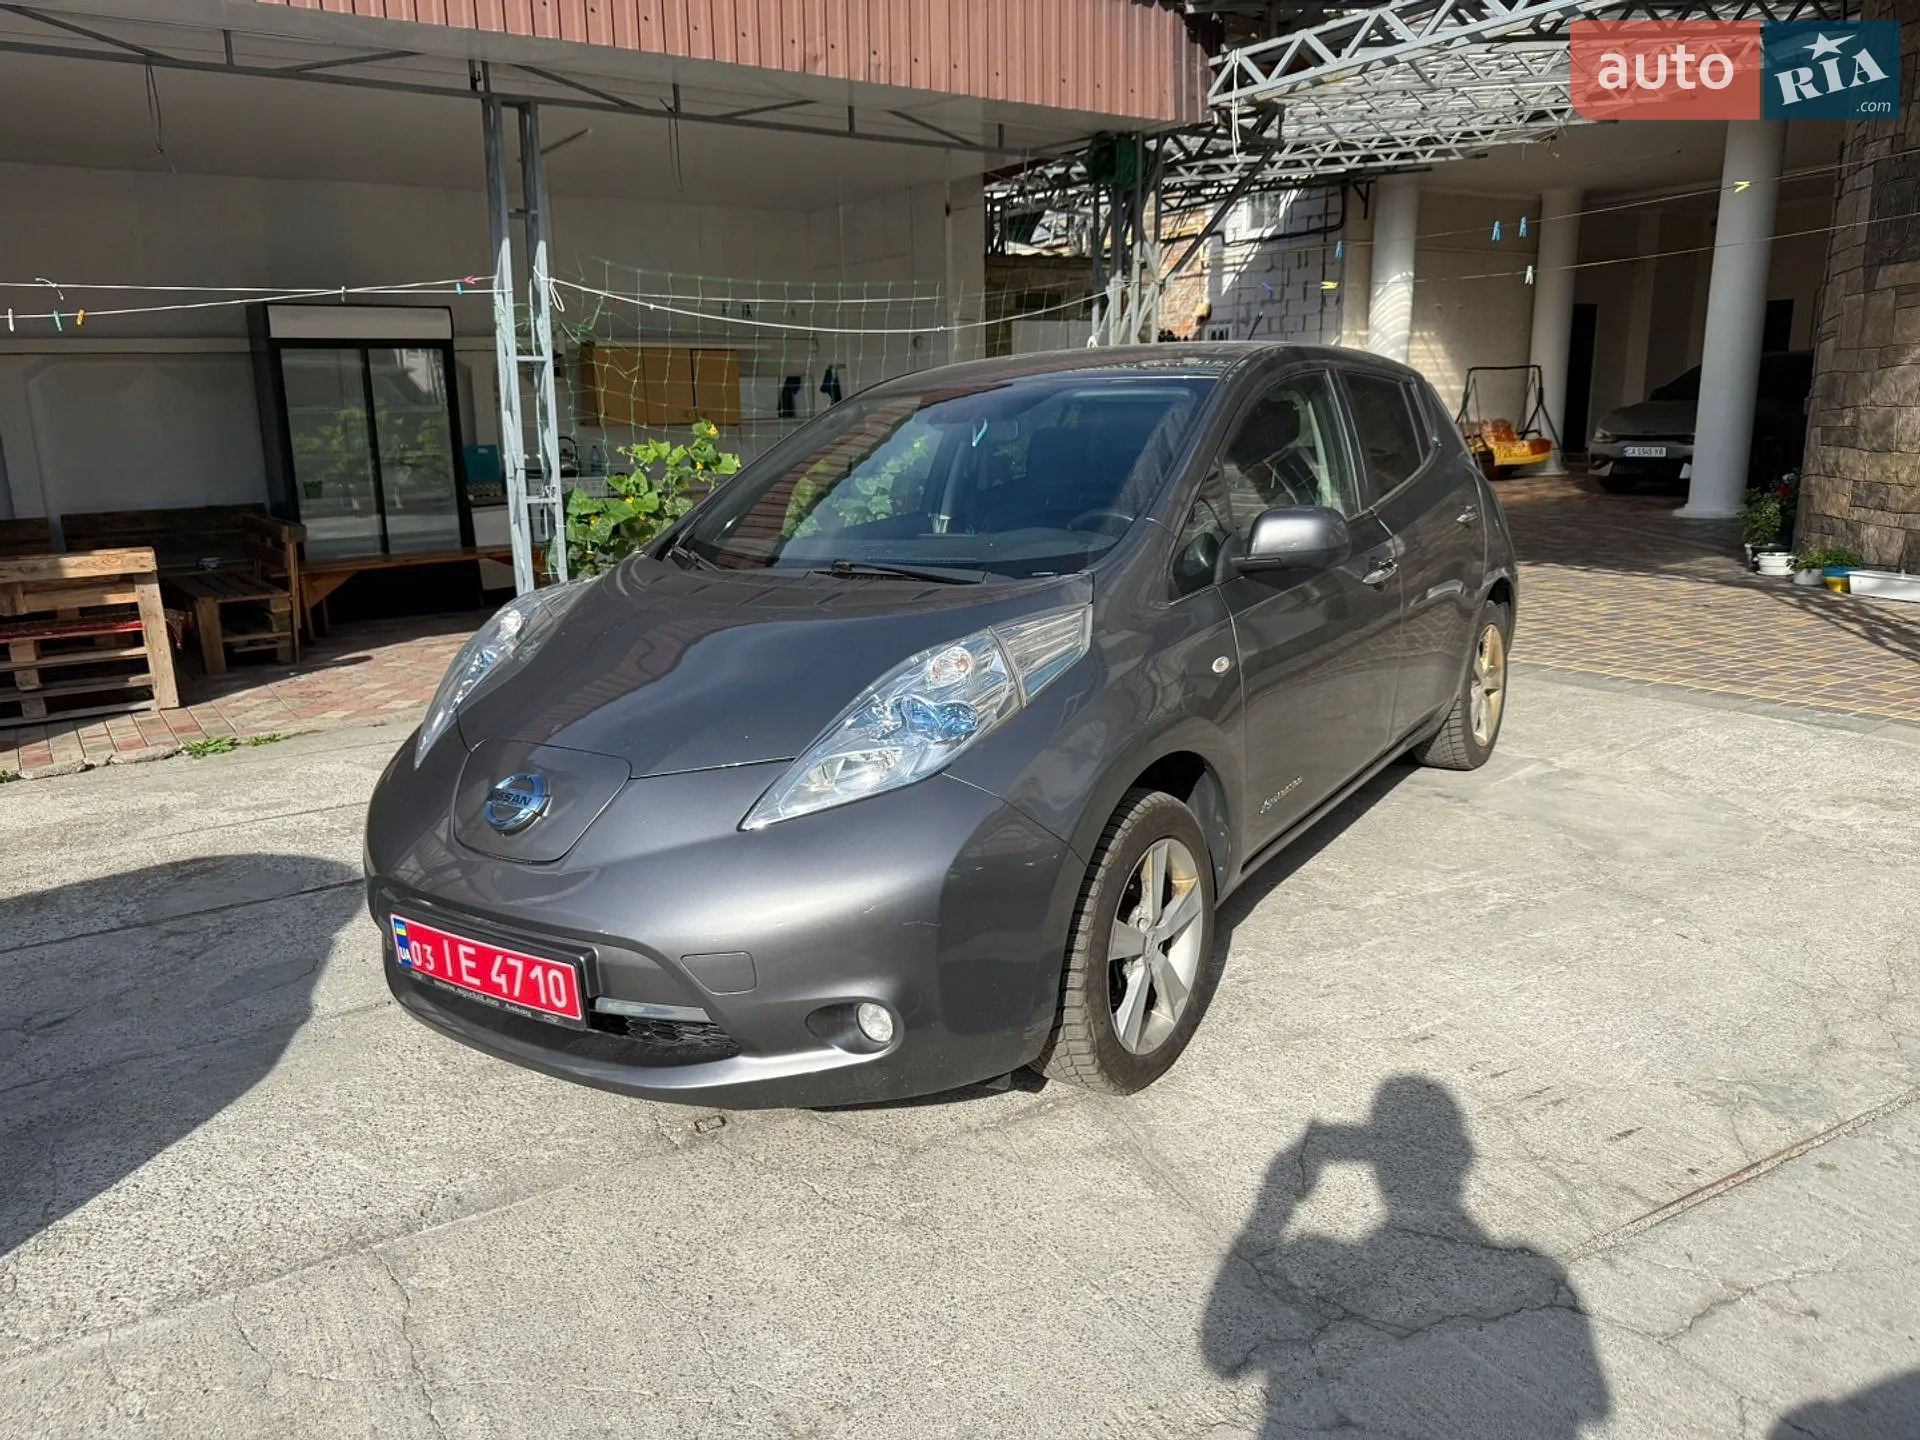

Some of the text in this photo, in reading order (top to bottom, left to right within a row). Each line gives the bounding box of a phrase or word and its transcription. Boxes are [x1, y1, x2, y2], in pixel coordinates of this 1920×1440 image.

[399, 946, 412, 961] UA
[411, 940, 435, 970] 03
[443, 939, 481, 986] IE
[490, 954, 568, 1009] 4710
